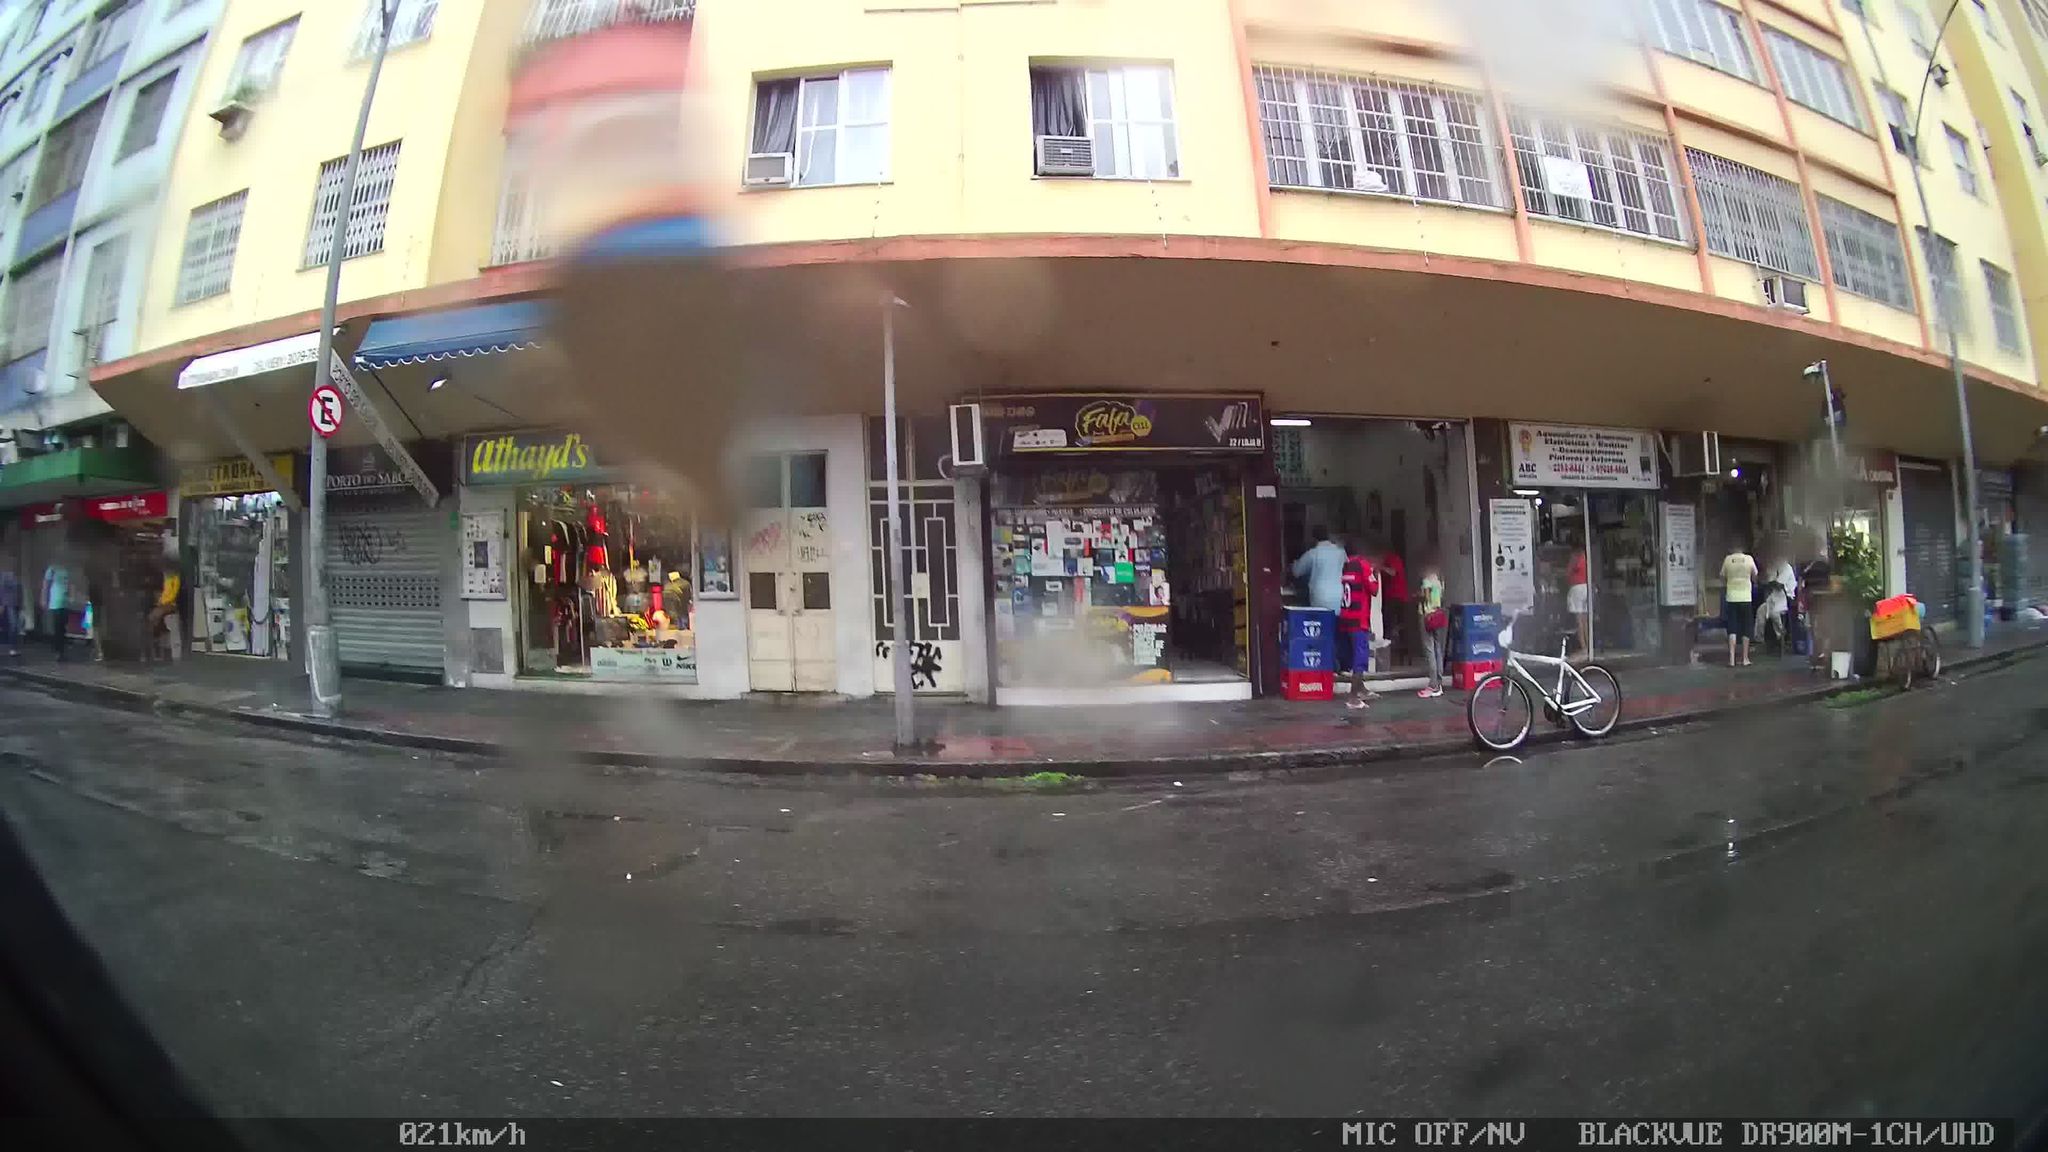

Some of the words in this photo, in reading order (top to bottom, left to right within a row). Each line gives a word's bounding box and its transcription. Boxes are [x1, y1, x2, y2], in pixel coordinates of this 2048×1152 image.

[320, 396, 333, 425] E
[1518, 462, 1536, 472] ABC
[326, 474, 361, 488] PORTO
